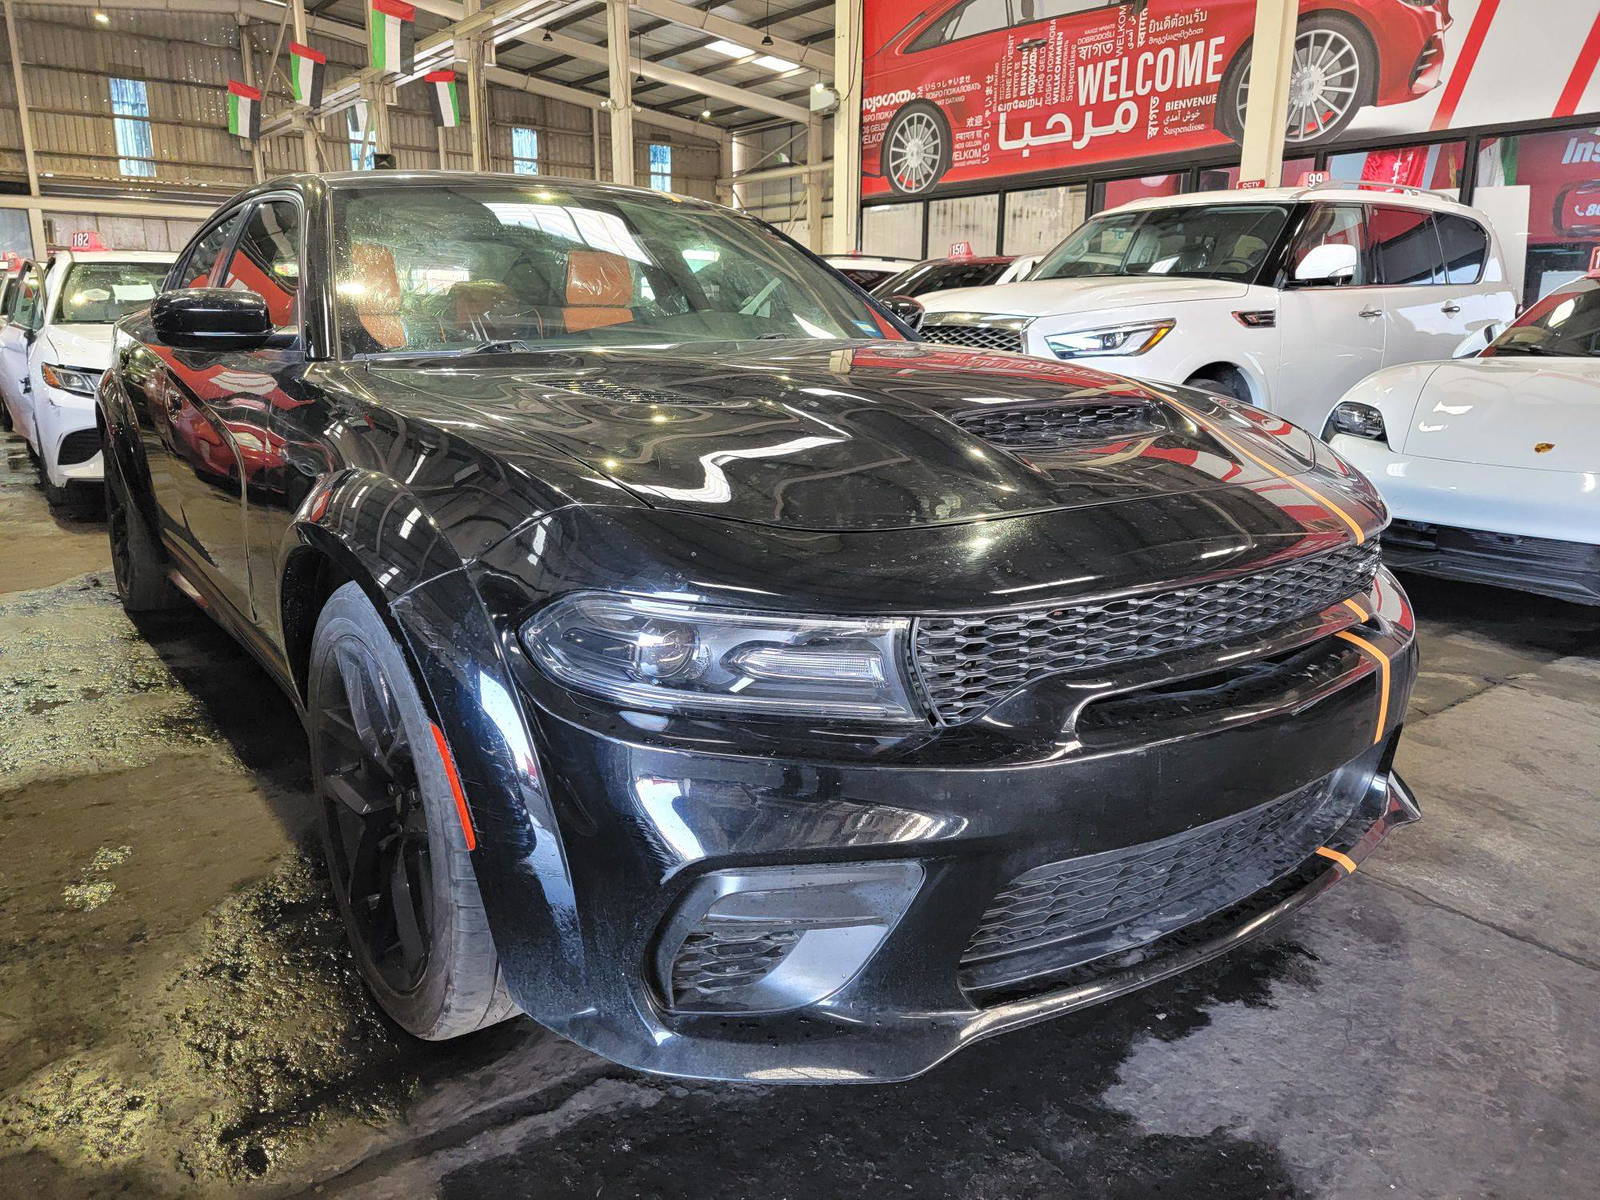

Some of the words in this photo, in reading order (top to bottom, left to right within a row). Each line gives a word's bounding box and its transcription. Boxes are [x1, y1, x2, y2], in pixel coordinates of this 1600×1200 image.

[1116, 5, 1127, 57] WELKOM
[1052, 32, 1064, 104] WILLKOMMEN
[1077, 36, 1226, 107] WELCOME
[1165, 94, 1218, 112] BIENVENUE
[997, 100, 1139, 158] مرحبا
[1243, 181, 1260, 189] CCTV
[1307, 172, 1323, 188] 99
[73, 233, 89, 247] 182
[952, 242, 965, 256] 150
